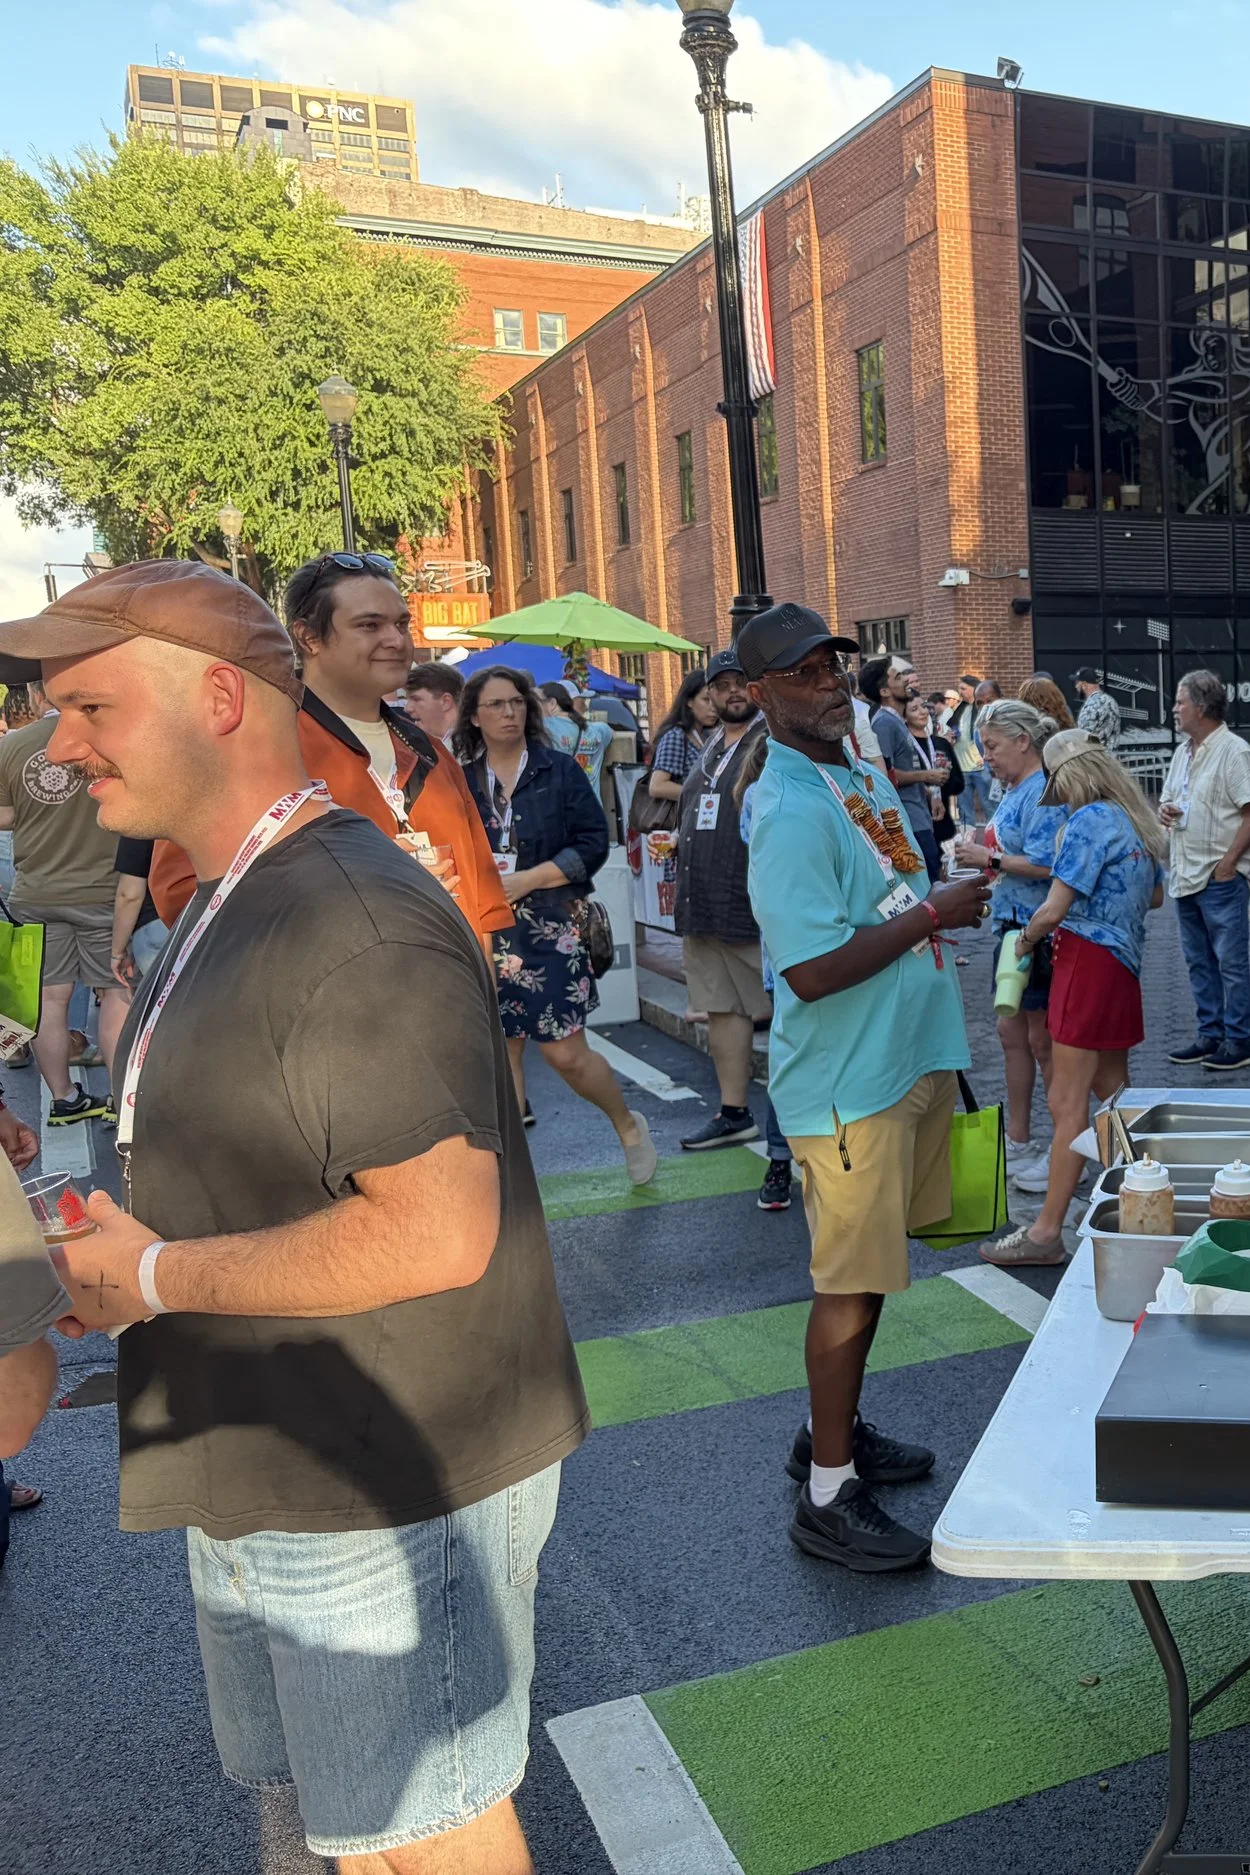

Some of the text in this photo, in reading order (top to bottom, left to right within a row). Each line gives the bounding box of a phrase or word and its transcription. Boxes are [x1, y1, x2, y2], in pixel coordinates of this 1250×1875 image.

[325, 103, 365, 123] PNC
[423, 602, 478, 625] BIG BAT
[27, 781, 69, 800] BREWING
